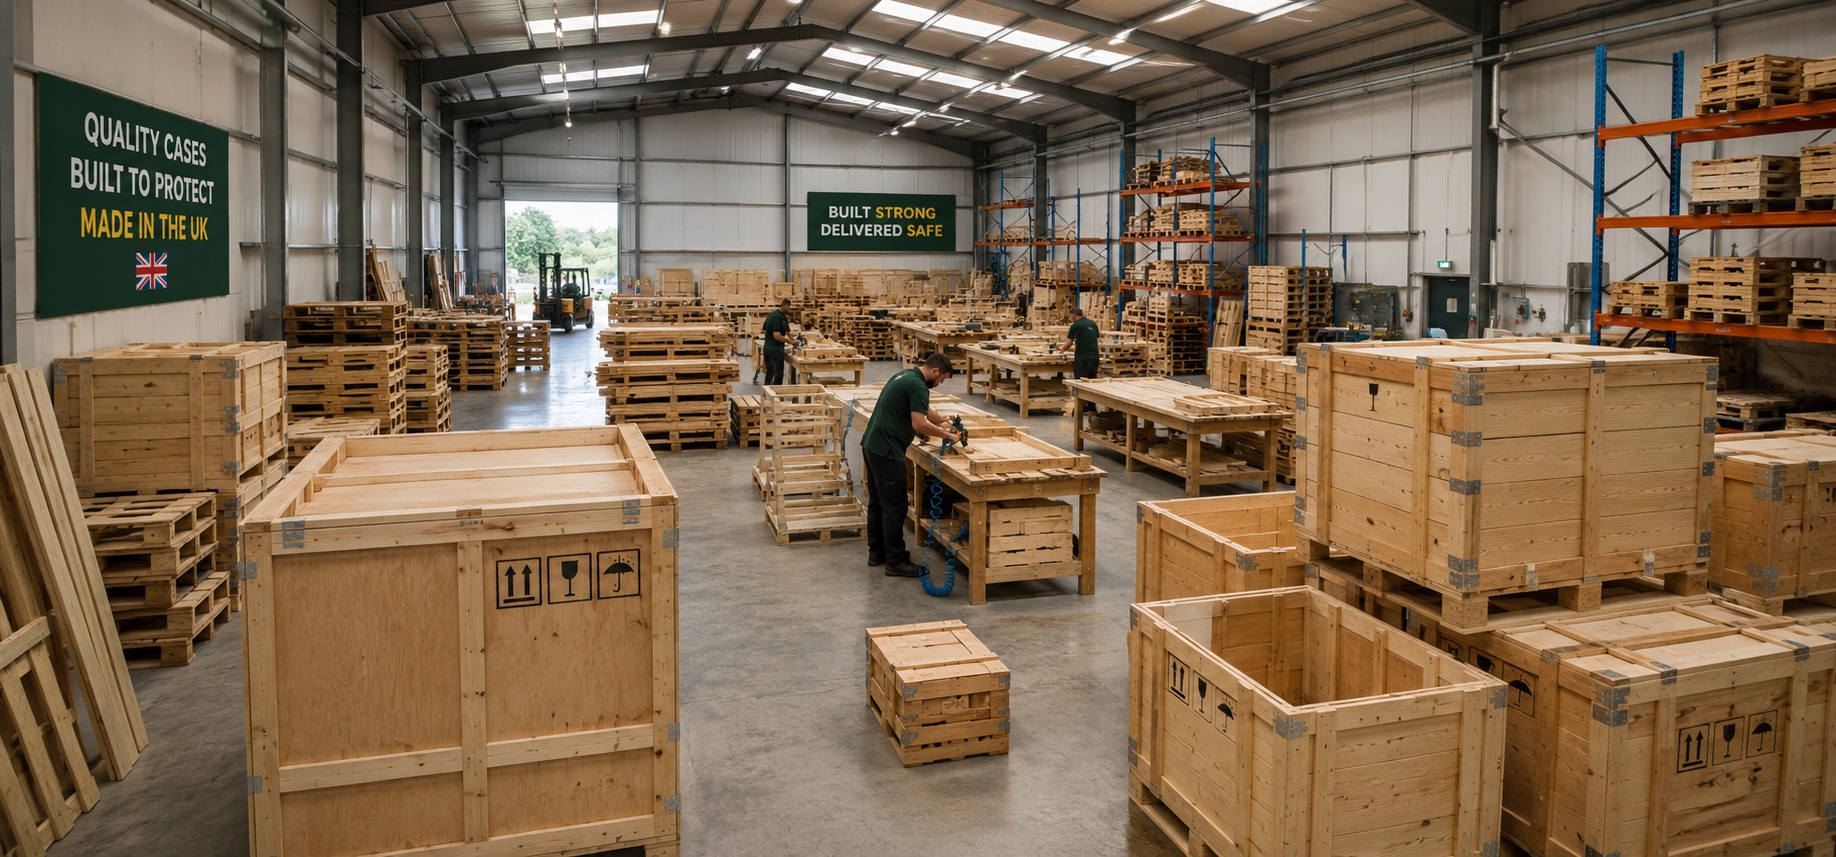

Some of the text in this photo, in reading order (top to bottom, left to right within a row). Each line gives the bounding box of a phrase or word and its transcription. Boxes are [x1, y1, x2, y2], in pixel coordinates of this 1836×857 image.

[84, 112, 207, 167] QUALITY CASES
[70, 157, 214, 204] BUILT TO PROTECT
[80, 207, 208, 240] MADE IN THE UK
[828, 206, 936, 219] BUILT STRONG
[821, 223, 943, 237] DELIVERED SAFE
